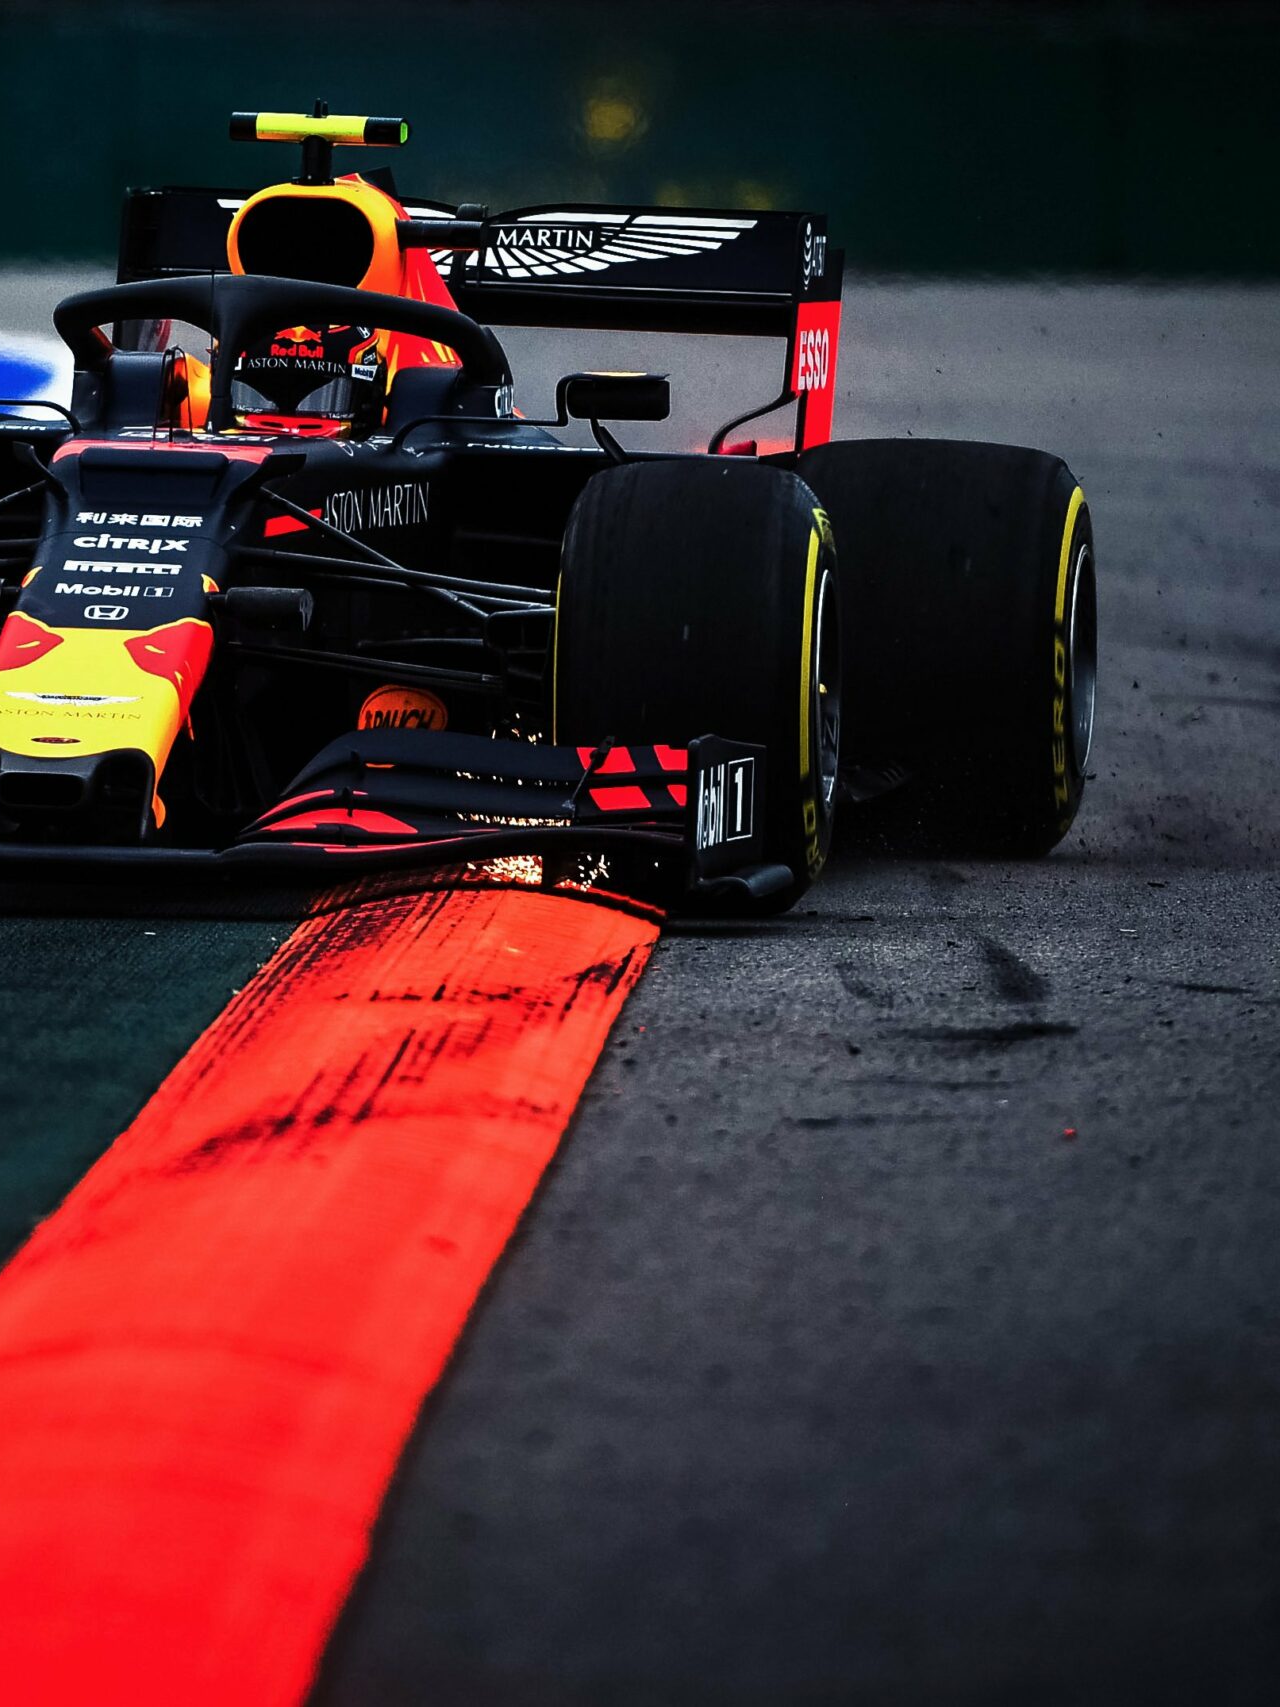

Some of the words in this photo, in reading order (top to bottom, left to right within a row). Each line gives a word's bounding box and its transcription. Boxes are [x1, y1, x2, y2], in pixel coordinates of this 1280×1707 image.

[496, 228, 594, 249] MARTIN
[270, 343, 297, 358] Red
[298, 344, 325, 359] Bull
[248, 357, 288, 369] ASTON
[294, 358, 347, 375] MARTIN
[324, 489, 364, 534] ASTON
[368, 481, 430, 529] MARTIN
[75, 511, 204, 528] 利来国际
[63, 559, 183, 575] PIRELLI
[55, 583, 140, 597] Mobil
[64, 710, 142, 721] MARTIN
